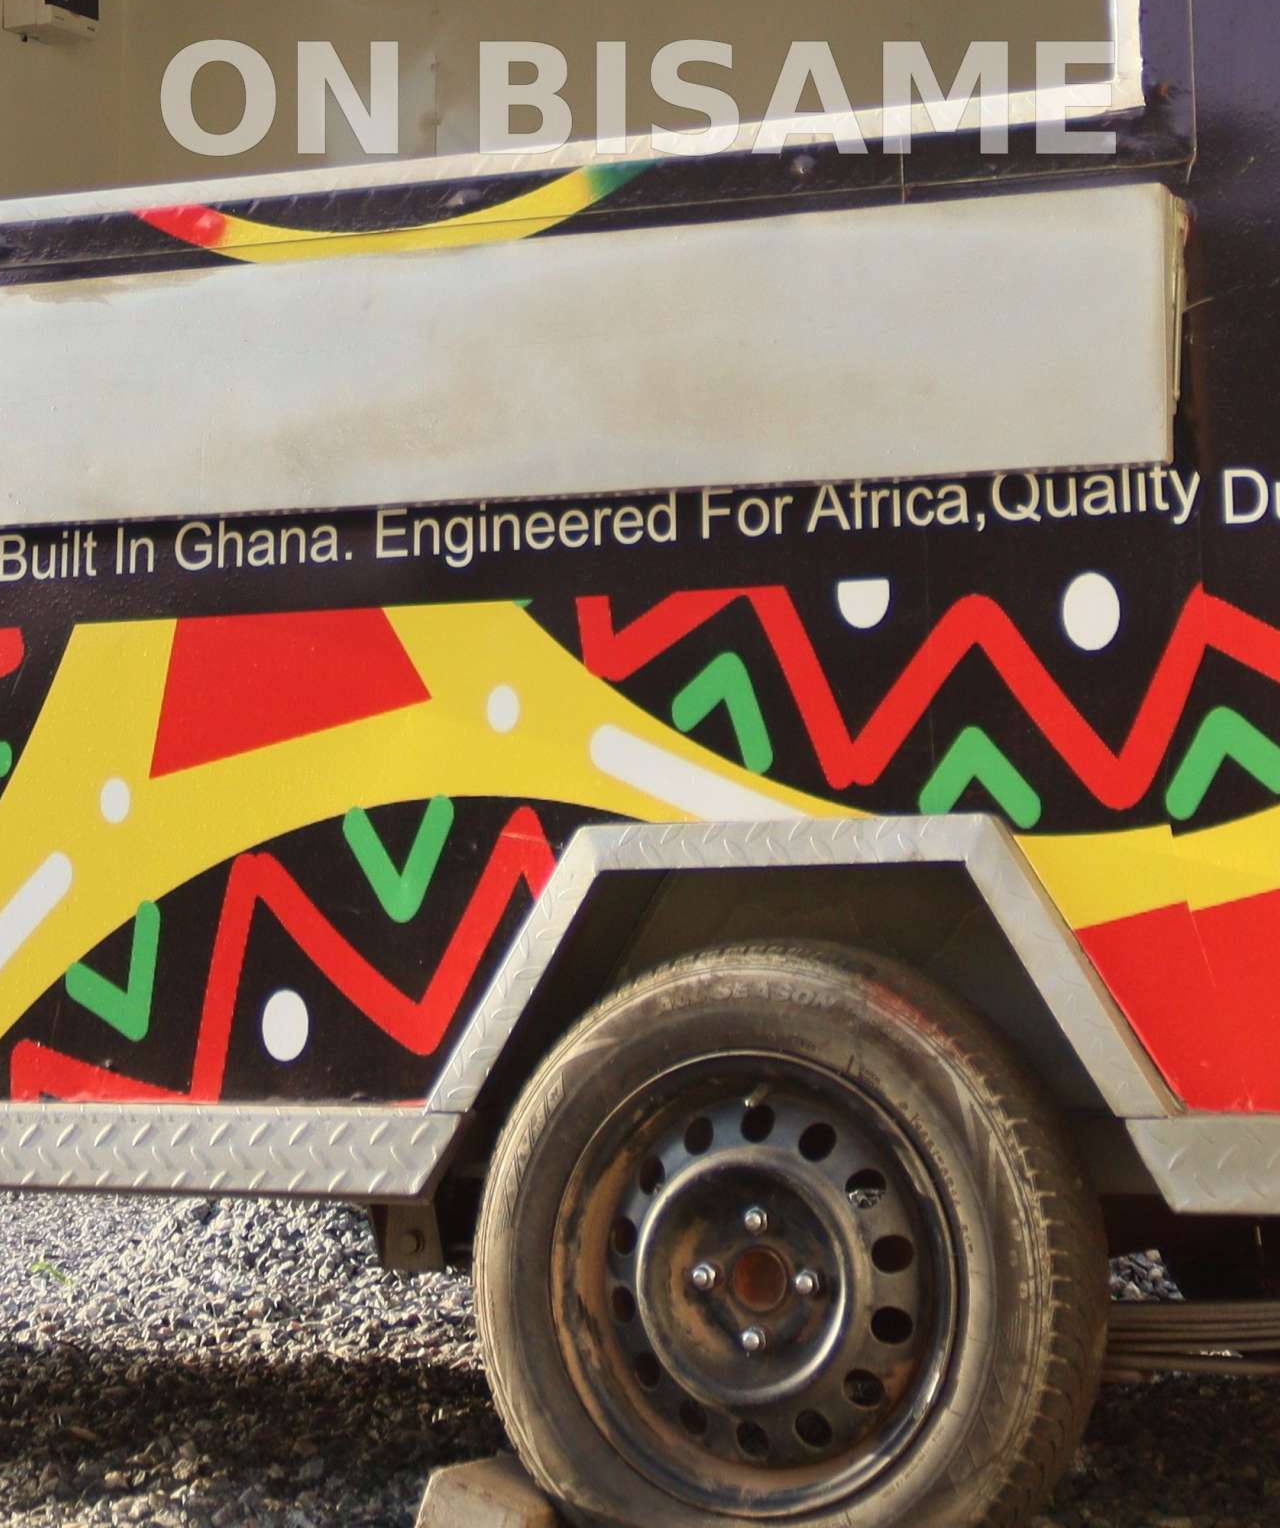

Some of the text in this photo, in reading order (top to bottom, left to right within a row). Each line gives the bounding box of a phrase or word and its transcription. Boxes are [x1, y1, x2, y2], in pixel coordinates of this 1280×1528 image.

[115, 527, 155, 577] In
[174, 520, 354, 572] Ghana.
[376, 490, 678, 568] Engineered
[702, 487, 794, 540] For
